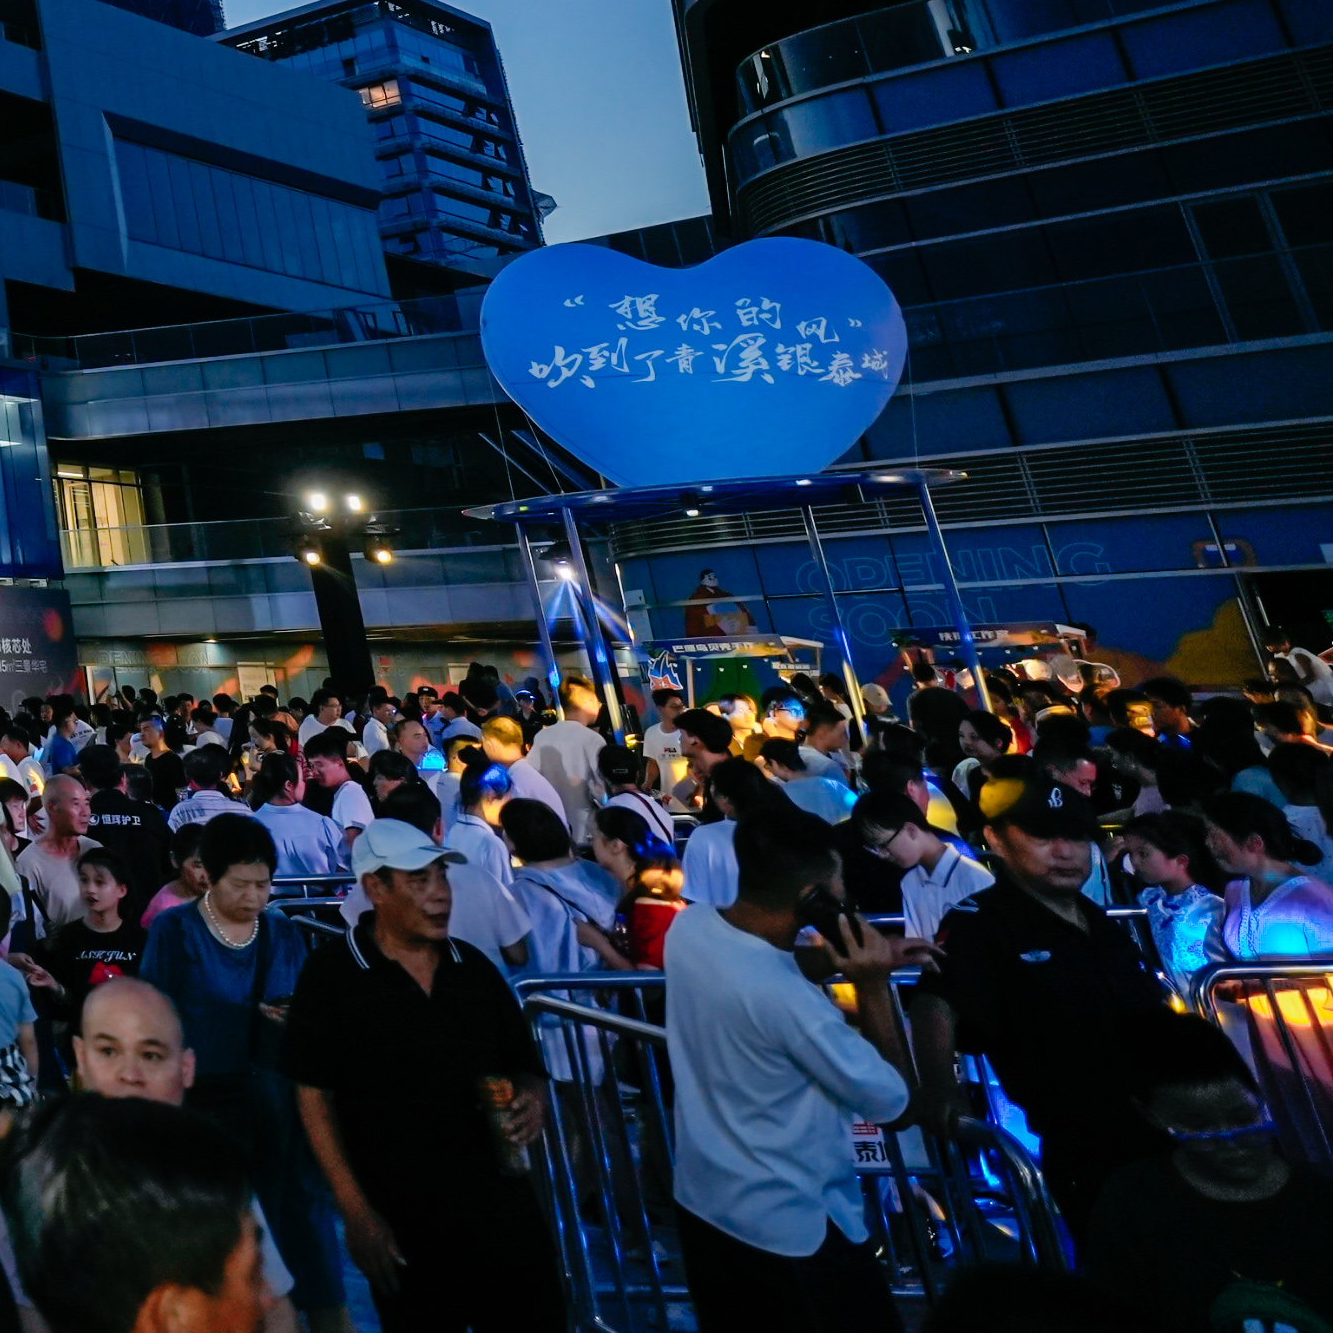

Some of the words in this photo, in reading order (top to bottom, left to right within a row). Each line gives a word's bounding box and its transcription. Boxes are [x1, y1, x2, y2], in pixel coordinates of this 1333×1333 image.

[529, 333, 888, 389] 吹到了青溪银泰城
